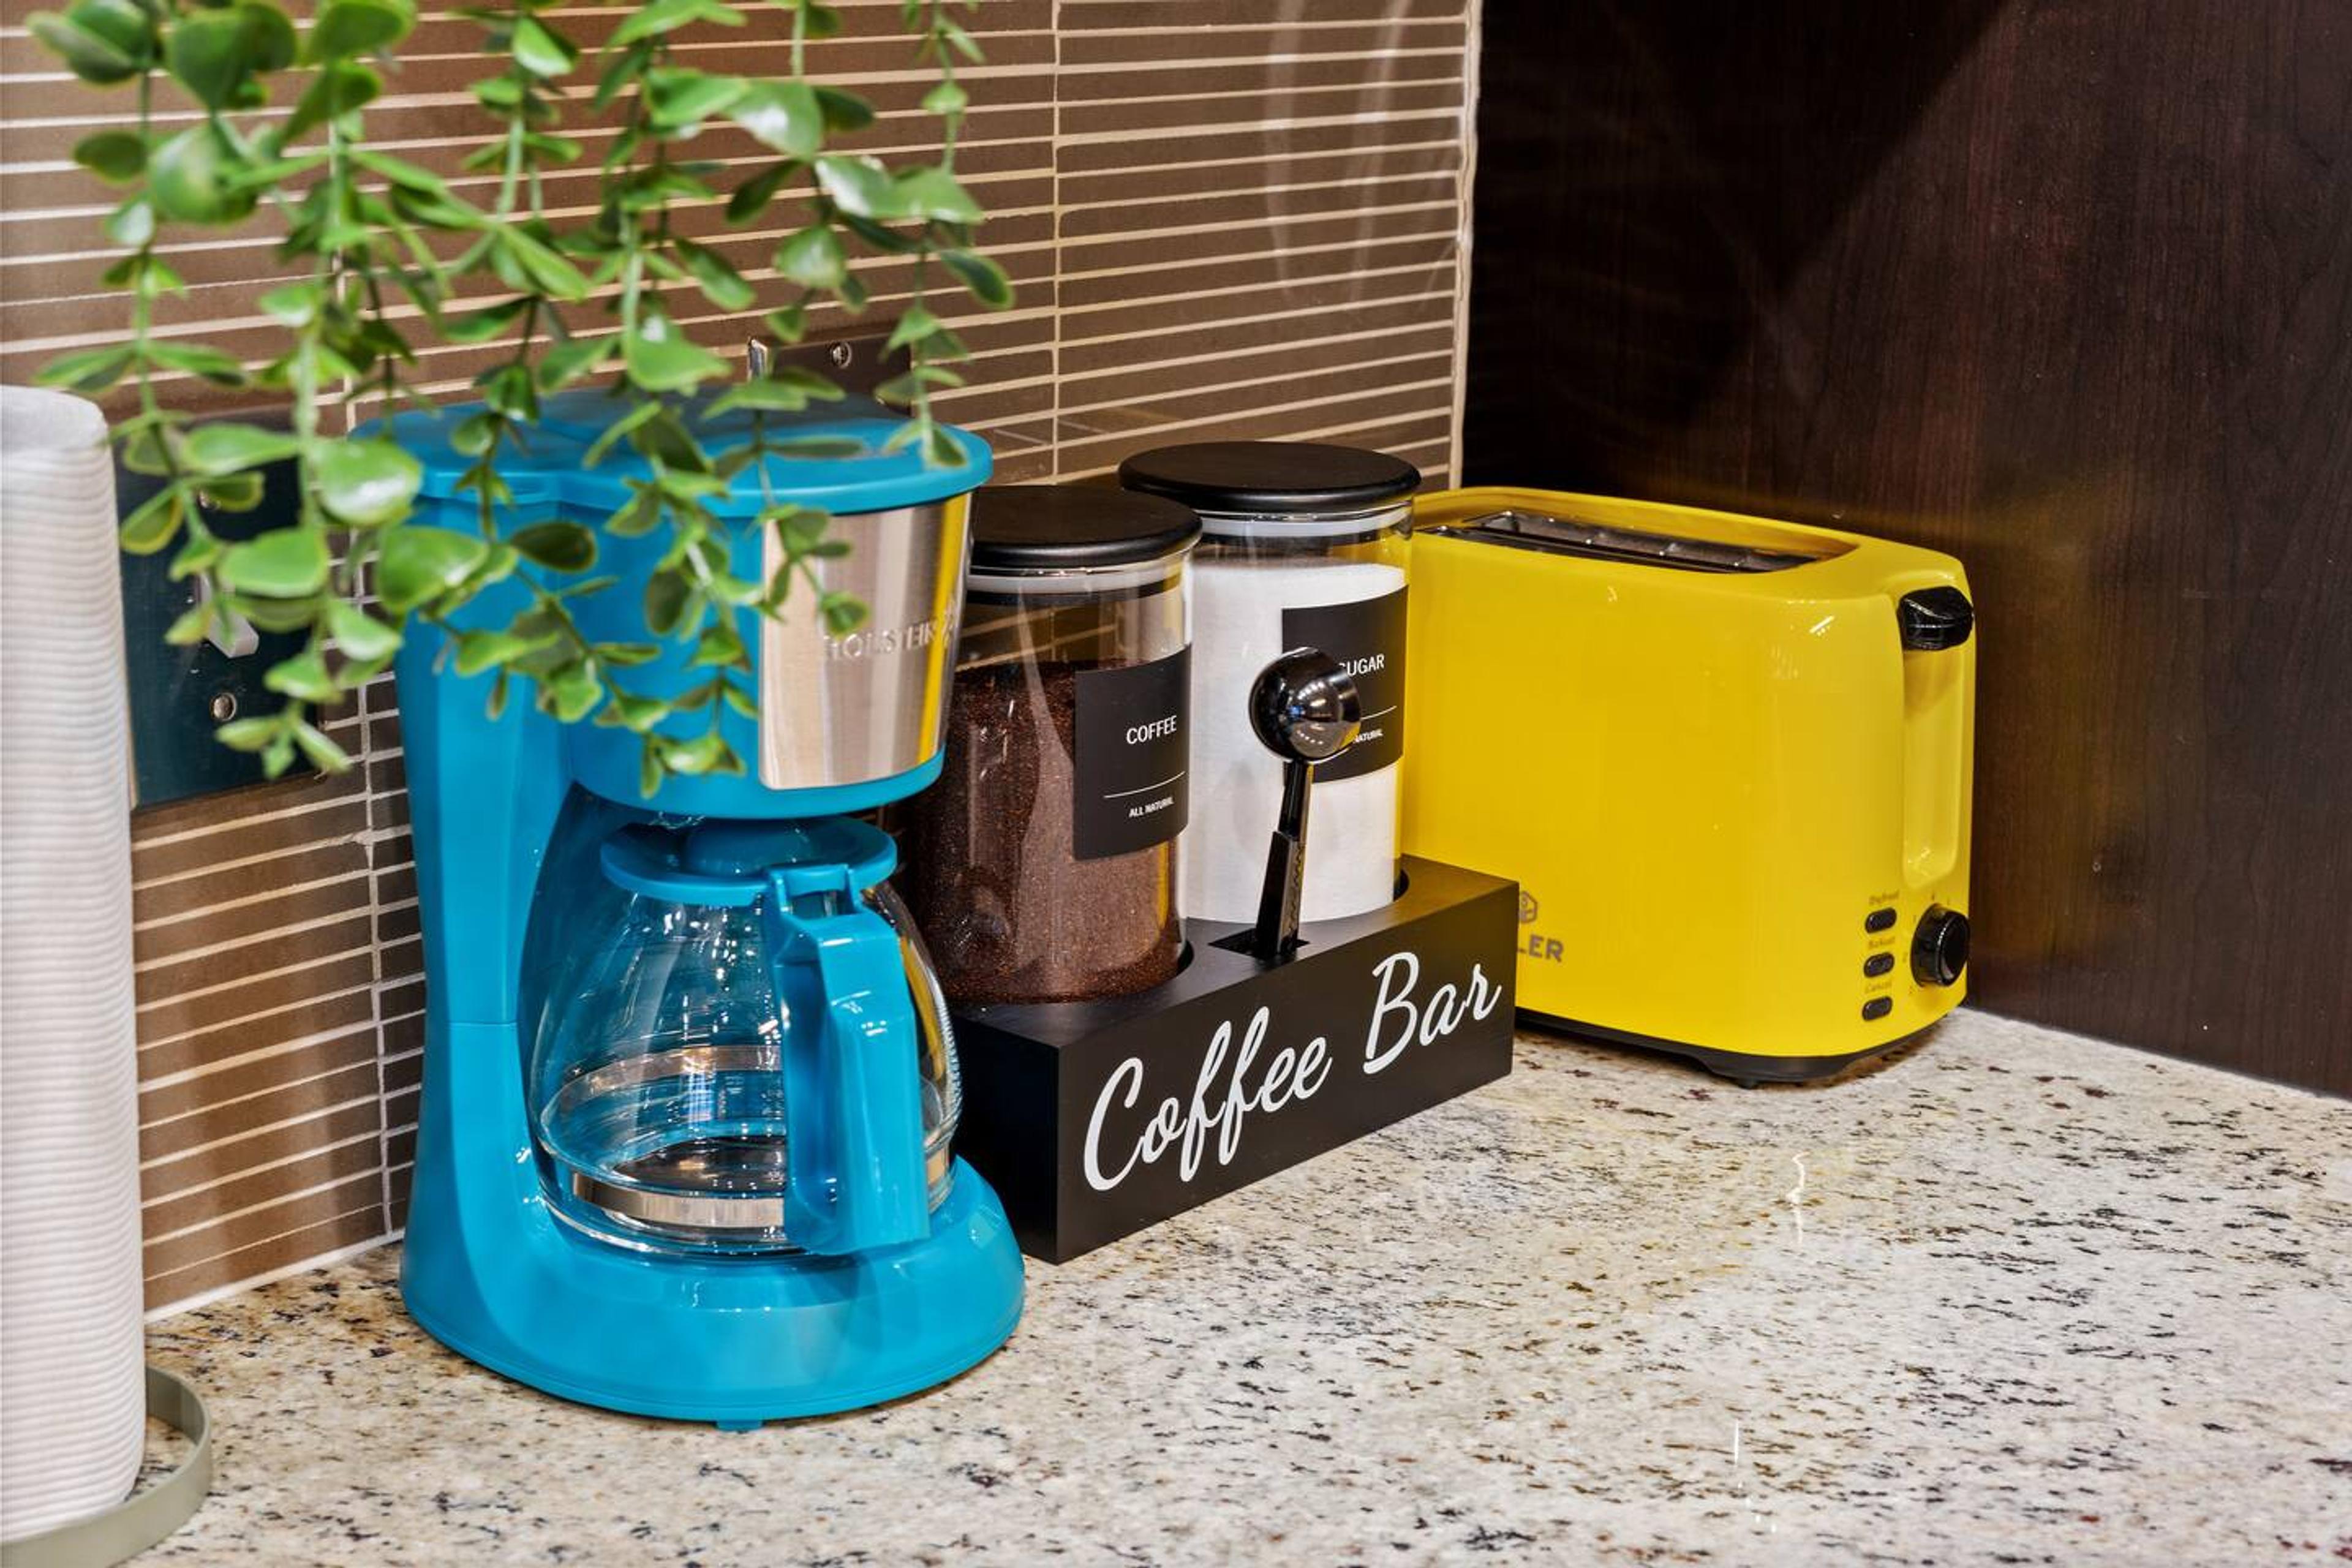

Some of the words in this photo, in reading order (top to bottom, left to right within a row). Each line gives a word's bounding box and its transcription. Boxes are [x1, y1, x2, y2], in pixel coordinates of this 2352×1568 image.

[1126, 715, 1177, 745] COFFEE
[1128, 807, 1144, 818] ALL
[1084, 1005, 1333, 1191] Coffee
[1362, 951, 1502, 1075] Bar
